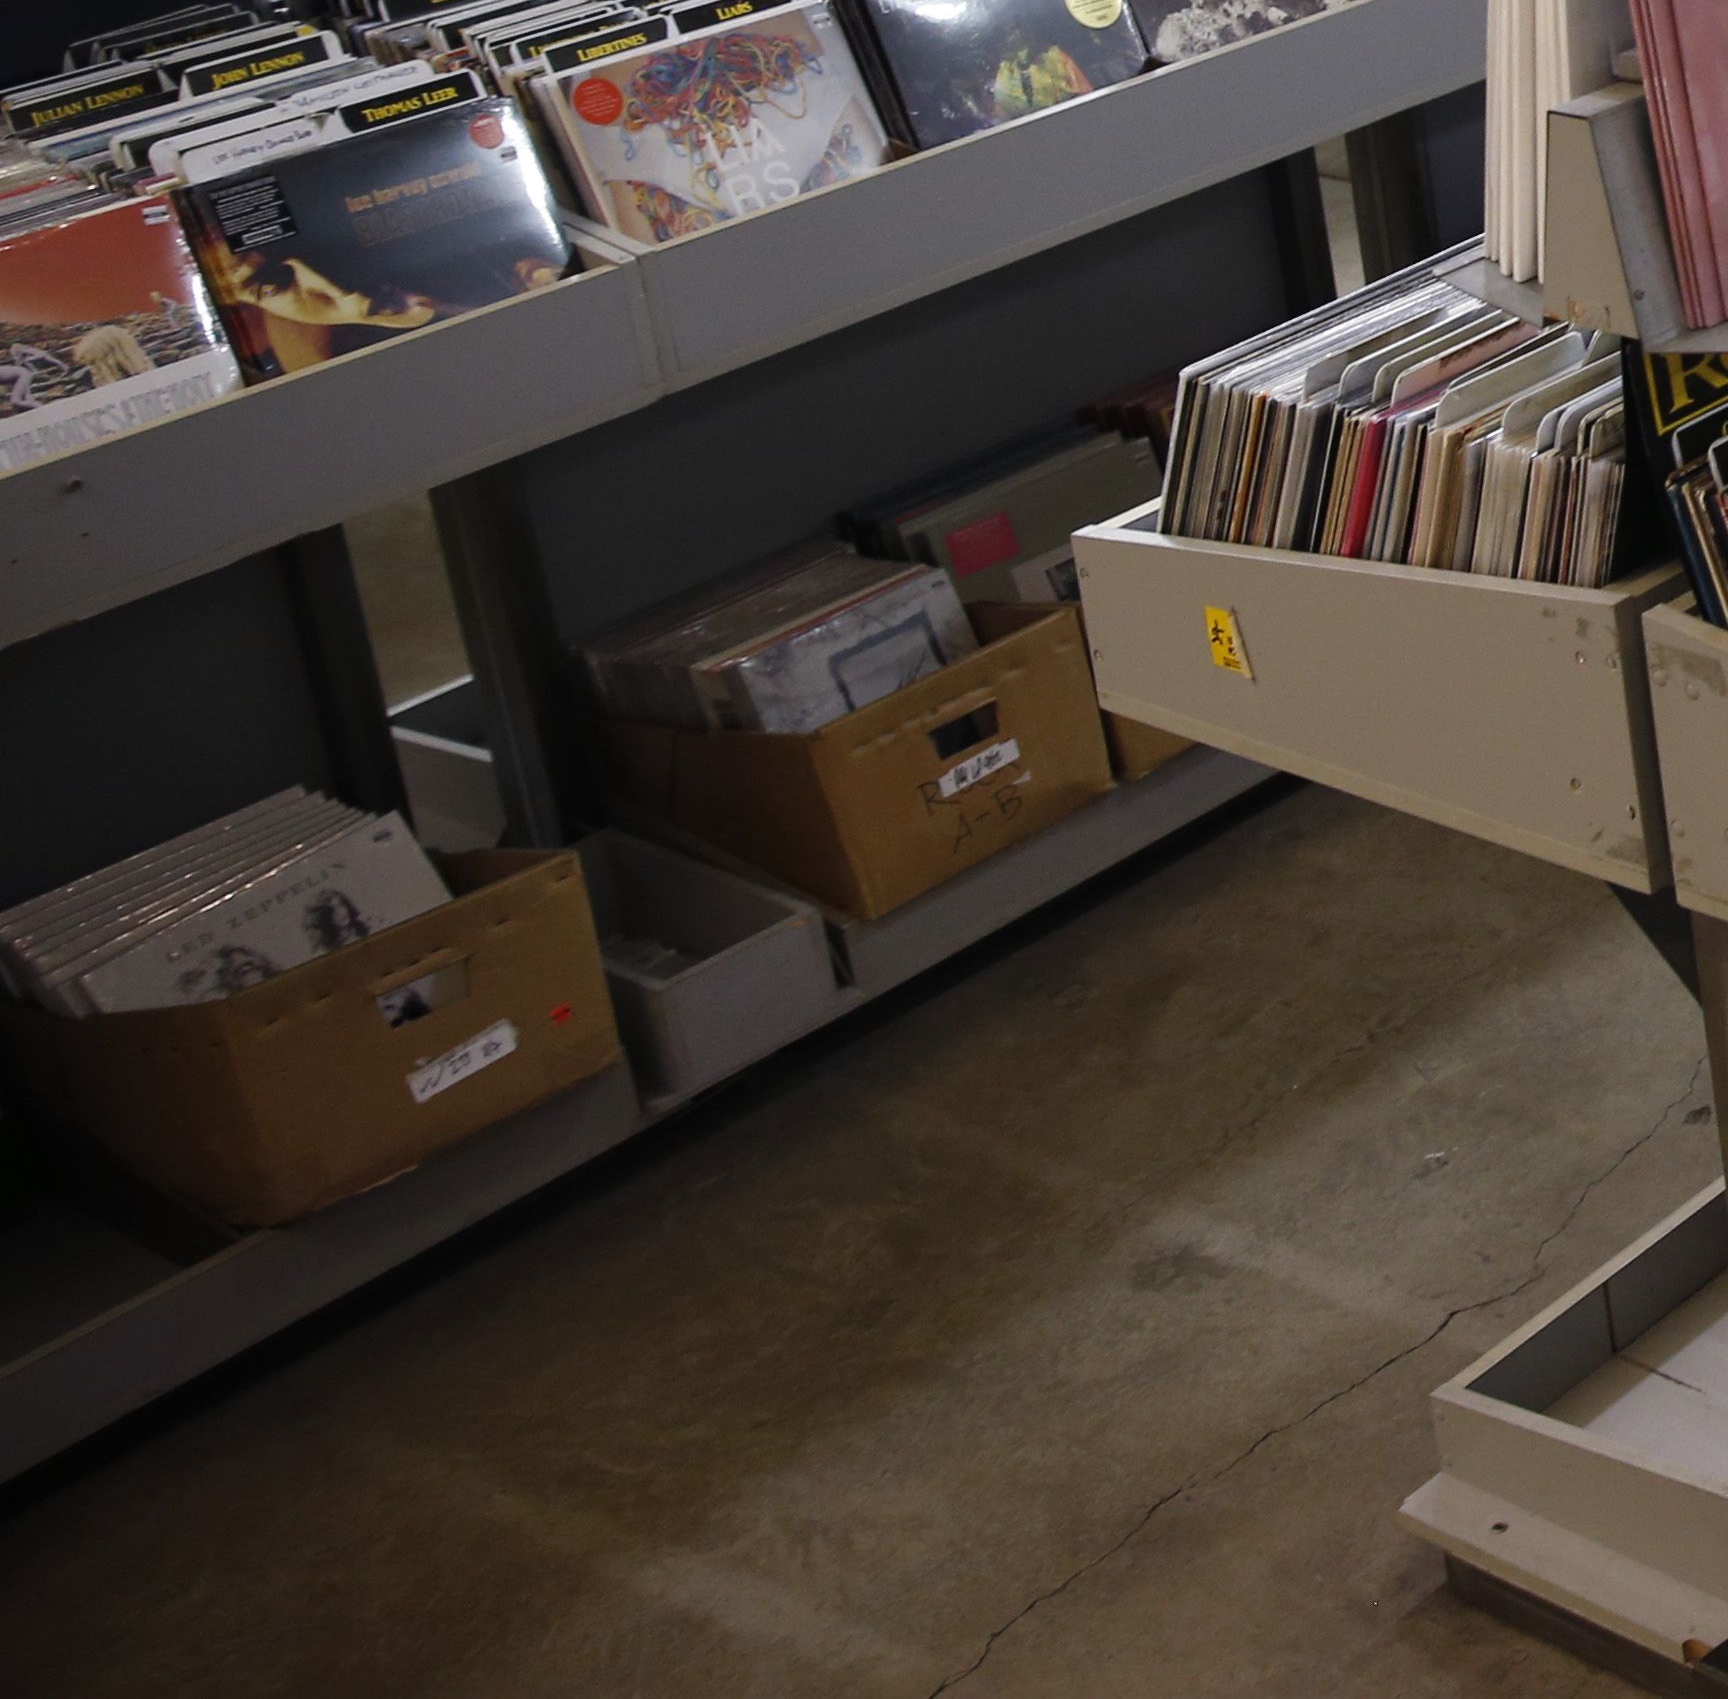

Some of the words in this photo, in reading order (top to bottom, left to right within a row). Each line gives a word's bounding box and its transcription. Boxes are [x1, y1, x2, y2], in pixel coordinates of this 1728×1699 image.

[715, 0, 754, 22] LIARS
[577, 32, 648, 63] LIBERTINES
[210, 65, 247, 91] JOHN
[248, 49, 305, 79] LENNON
[29, 97, 82, 128] JULIAN
[83, 82, 145, 113] LENNON
[360, 98, 414, 125] THOMAS
[415, 86, 459, 111] LEER
[165, 930, 217, 964] LED
[225, 858, 350, 932] ZEPPELIN
